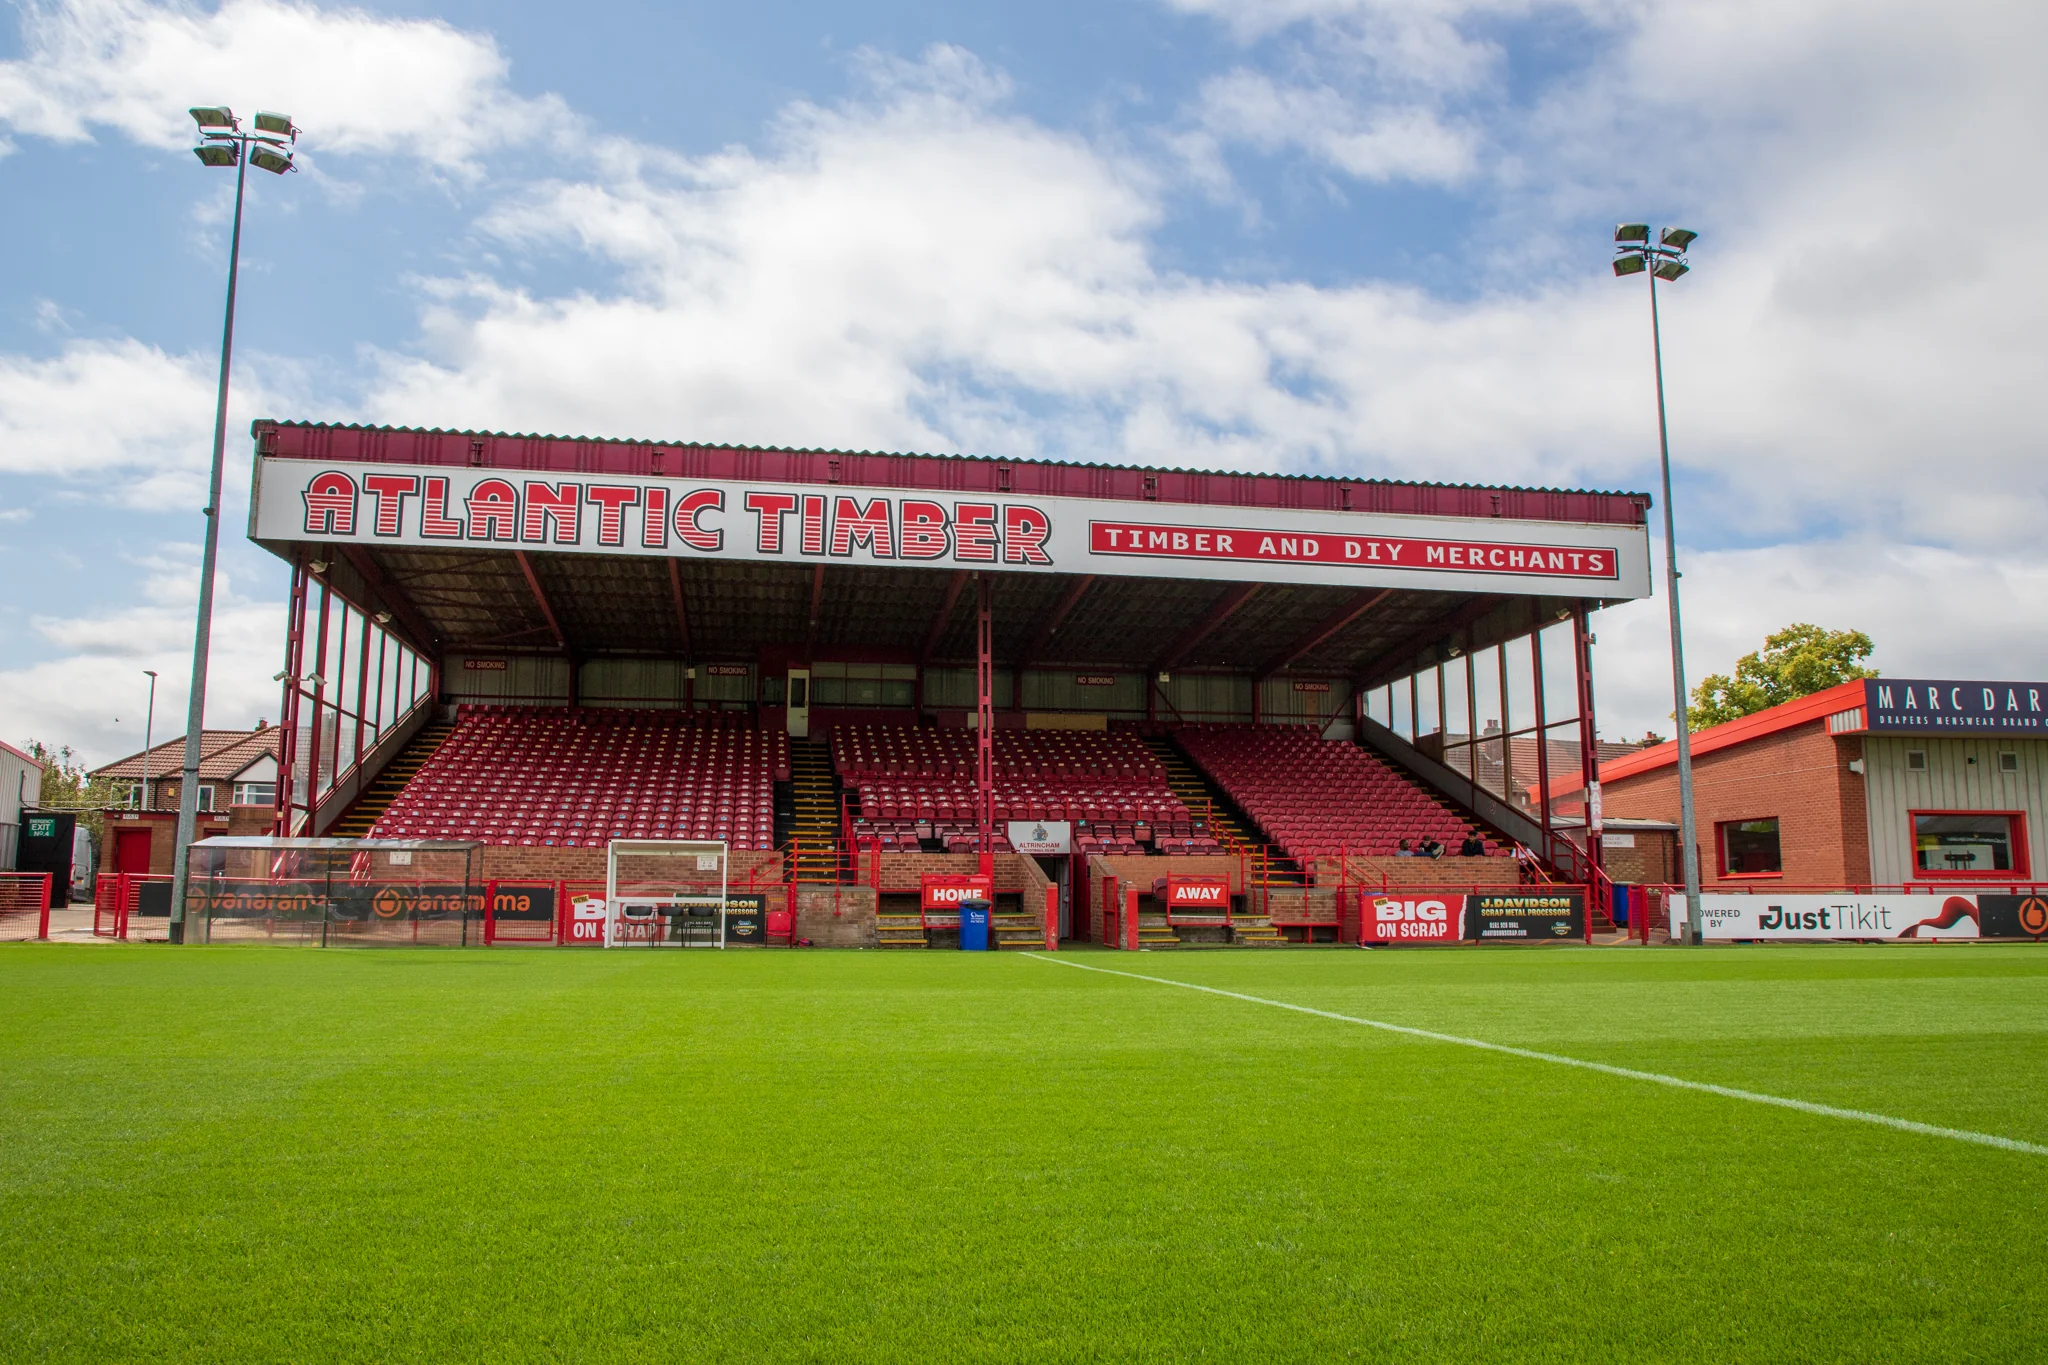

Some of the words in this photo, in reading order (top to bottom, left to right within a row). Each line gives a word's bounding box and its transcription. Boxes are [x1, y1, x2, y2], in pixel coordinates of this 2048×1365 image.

[301, 470, 725, 551] ATLANTIC
[744, 490, 1054, 565] TIMBER
[1105, 528, 1234, 552] TIMBER
[1258, 536, 1320, 556] AND
[1344, 541, 1403, 560] DIY
[1426, 545, 1605, 572] MERCHANTS
[476, 661, 505, 669] SMOKING
[708, 666, 718, 674] NO
[719, 666, 747, 675] SMOKING
[1088, 677, 1114, 685] SMOKING
[1304, 683, 1329, 691] SMOKING
[1878, 685, 1962, 711] MARC
[1983, 688, 2041, 712] DAR
[1879, 715, 1929, 725] DRAPERS
[1936, 717, 1995, 726] MENSWEAR
[2002, 718, 2038, 727] BRAND
[31, 823, 51, 831] EXIT
[933, 888, 983, 901] HOME
[1176, 887, 1221, 900] AWAY
[1481, 898, 1571, 908] J.DAVIDSON
[1376, 900, 1447, 921] BIG
[573, 922, 597, 938] ON
[1376, 922, 1397, 938] ON
[1400, 922, 1447, 938] SCRAP
[1710, 920, 1723, 928] BY
